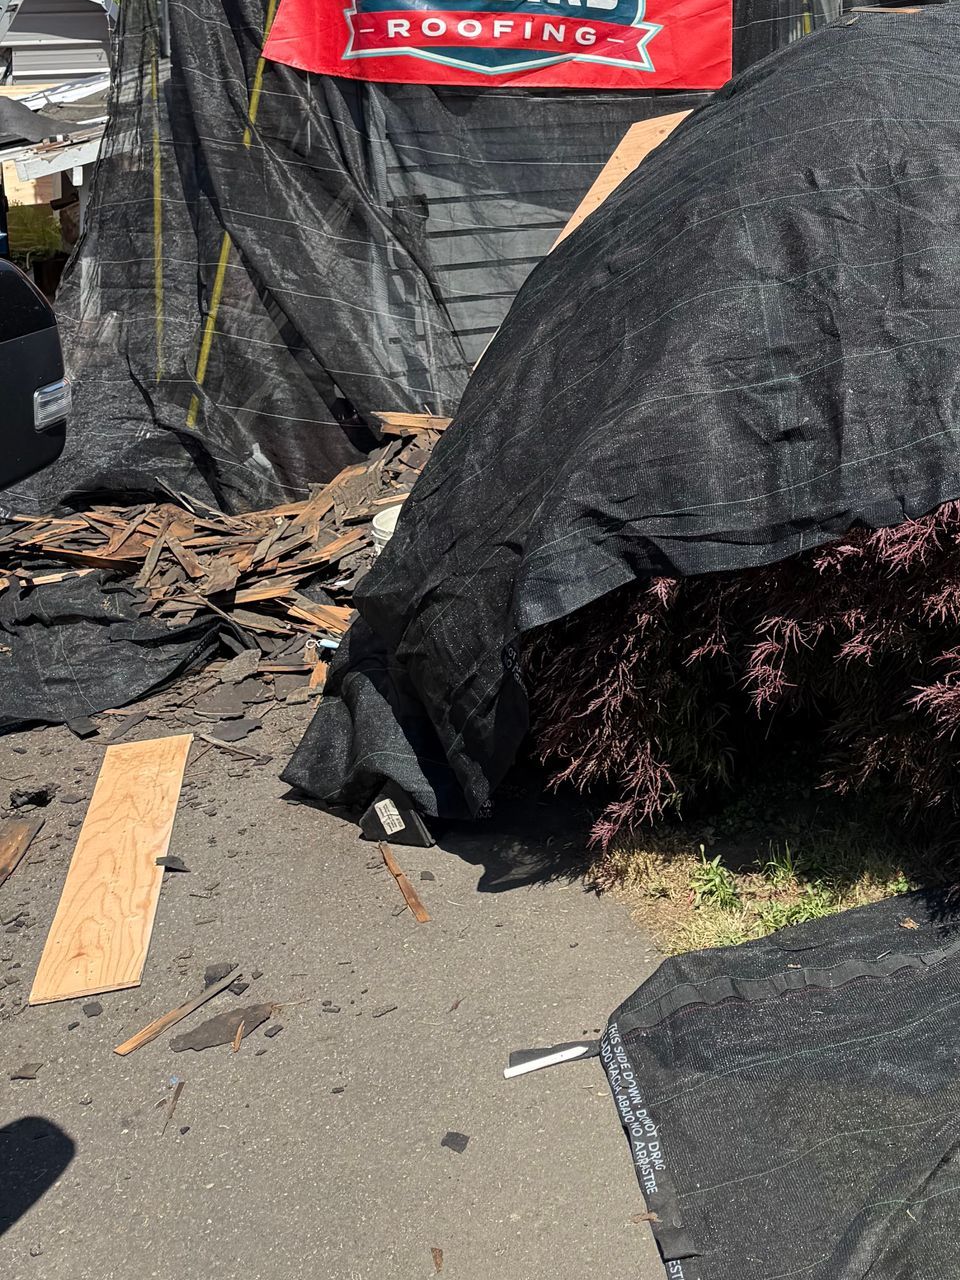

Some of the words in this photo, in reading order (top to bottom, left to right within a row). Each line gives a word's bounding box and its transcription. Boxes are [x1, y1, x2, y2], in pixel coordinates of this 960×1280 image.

[387, 19, 597, 46] ROOFING
[608, 1023, 621, 1045] THIS
[614, 1046, 631, 1069] SIDE
[622, 1071, 643, 1104] DOWN
[629, 1122, 643, 1137] NO
[641, 1118, 658, 1138] NOT
[648, 1141, 666, 1171] DRAG
[633, 1141, 658, 1195] ARRASTRE
[668, 1259, 685, 1280] EST
